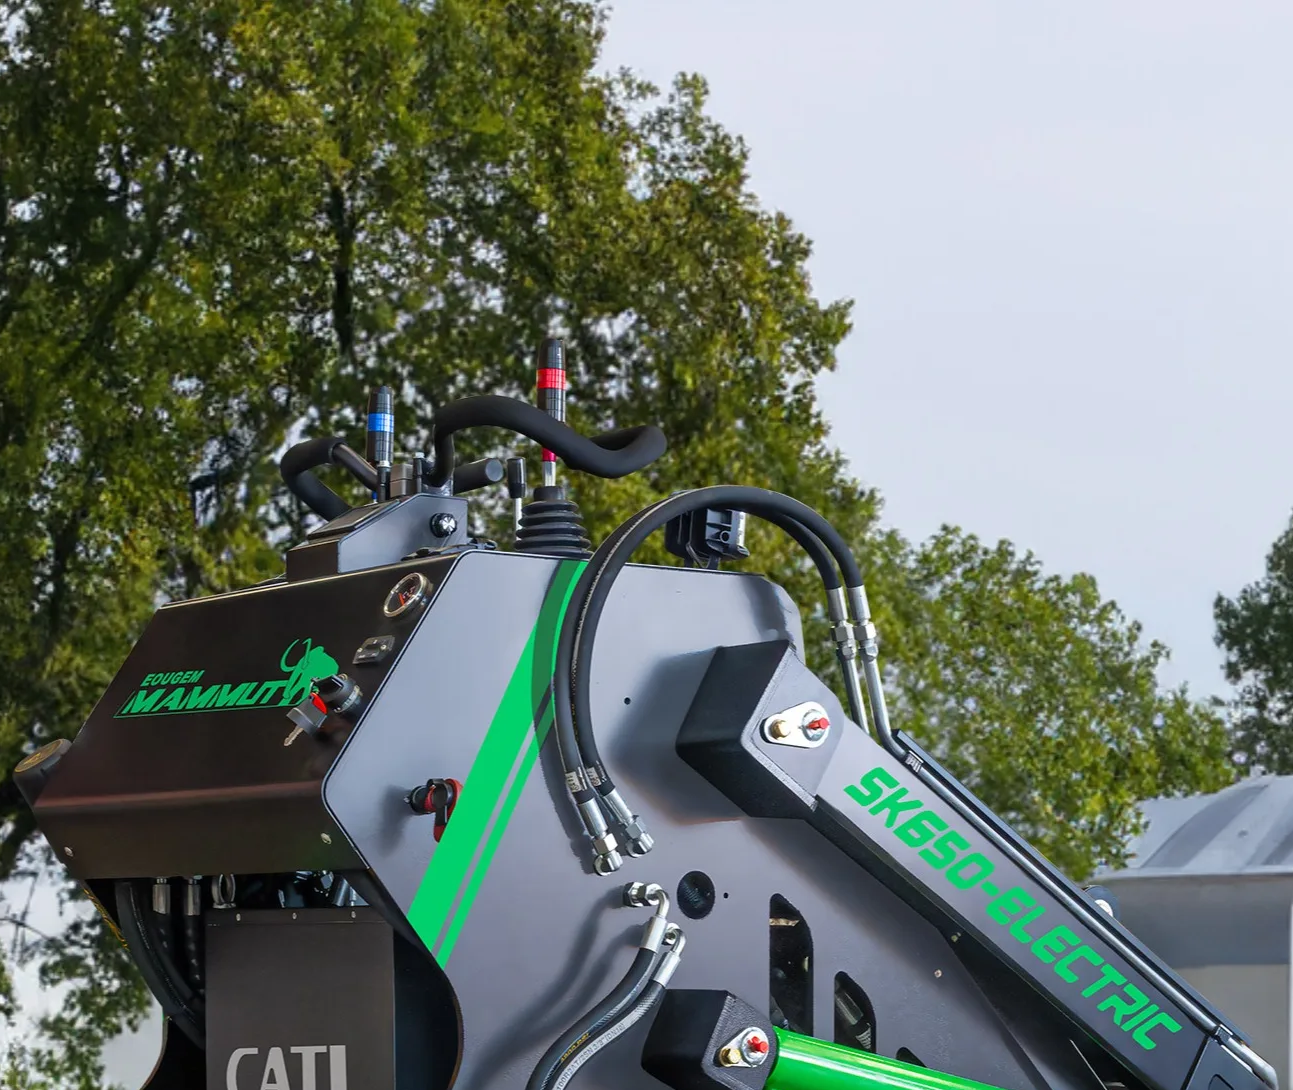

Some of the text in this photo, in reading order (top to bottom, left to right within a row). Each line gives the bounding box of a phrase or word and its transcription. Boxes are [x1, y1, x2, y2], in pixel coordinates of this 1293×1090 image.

[140, 669, 206, 687] EOUGEM
[121, 680, 289, 714] MAMMUT
[843, 767, 1183, 1050] SK650-ELECTRIC
